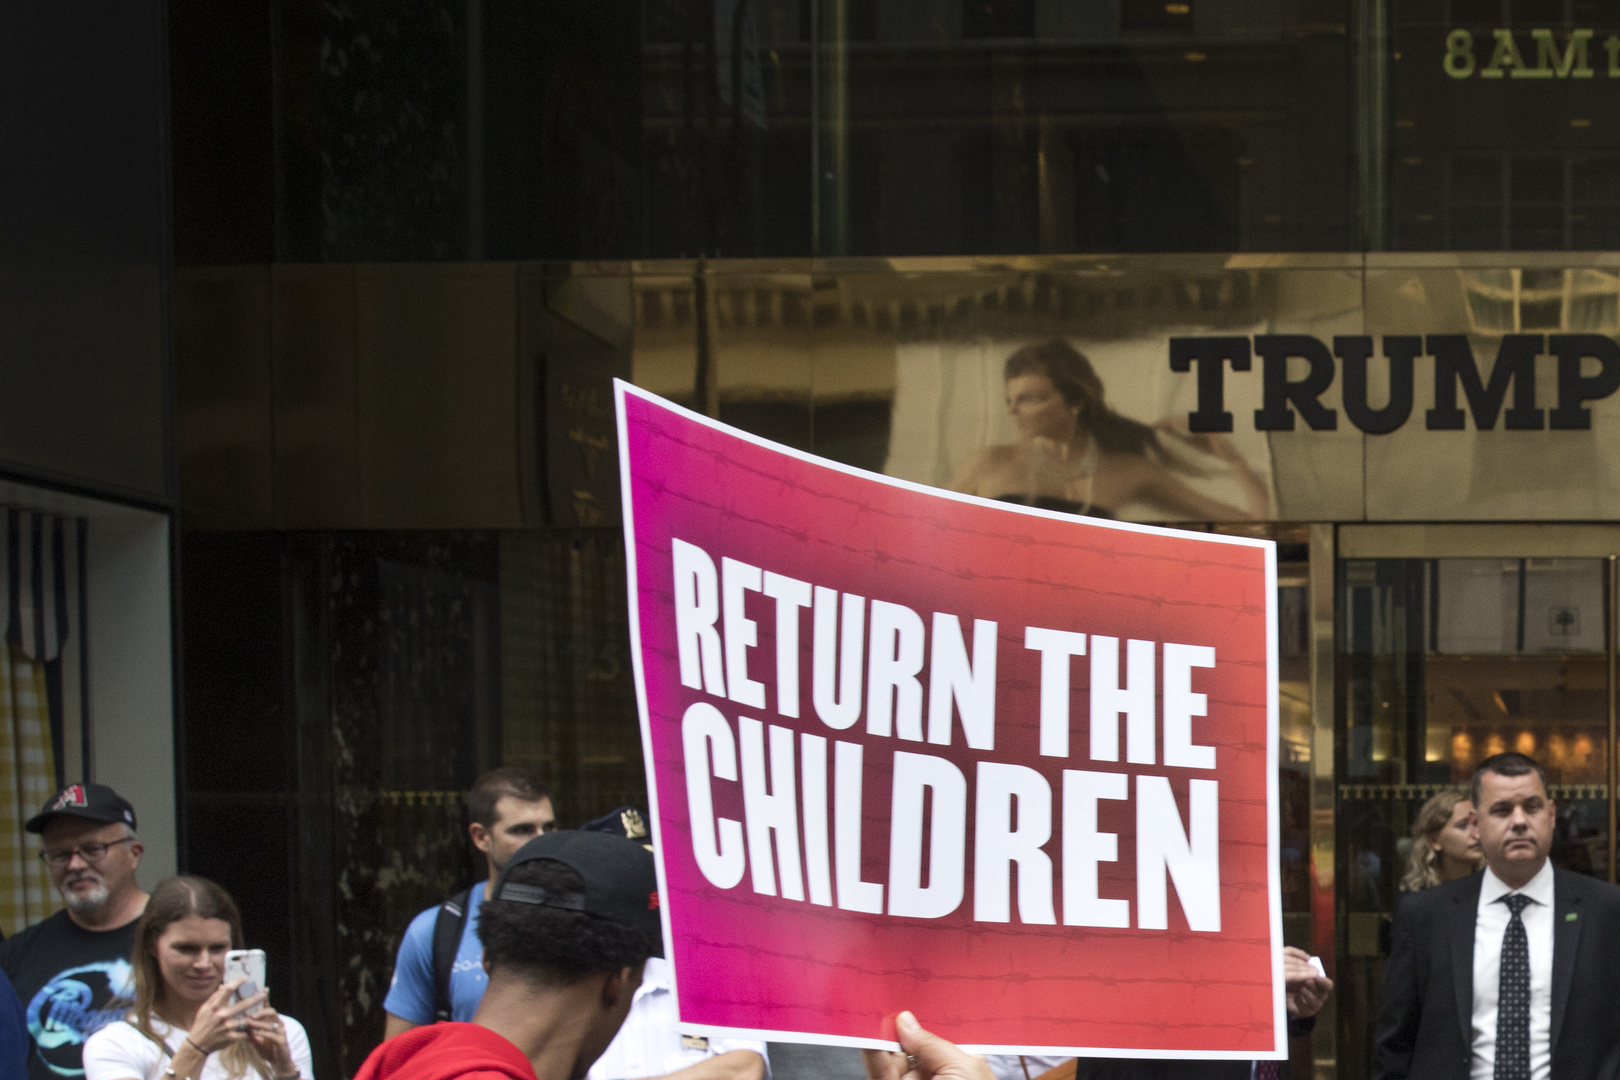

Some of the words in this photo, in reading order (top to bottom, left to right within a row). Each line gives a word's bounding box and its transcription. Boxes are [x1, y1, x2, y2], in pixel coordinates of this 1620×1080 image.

[671, 537, 999, 751] RETURN
[1024, 625, 1217, 769] THE
[681, 701, 1222, 932] CHILDREN
